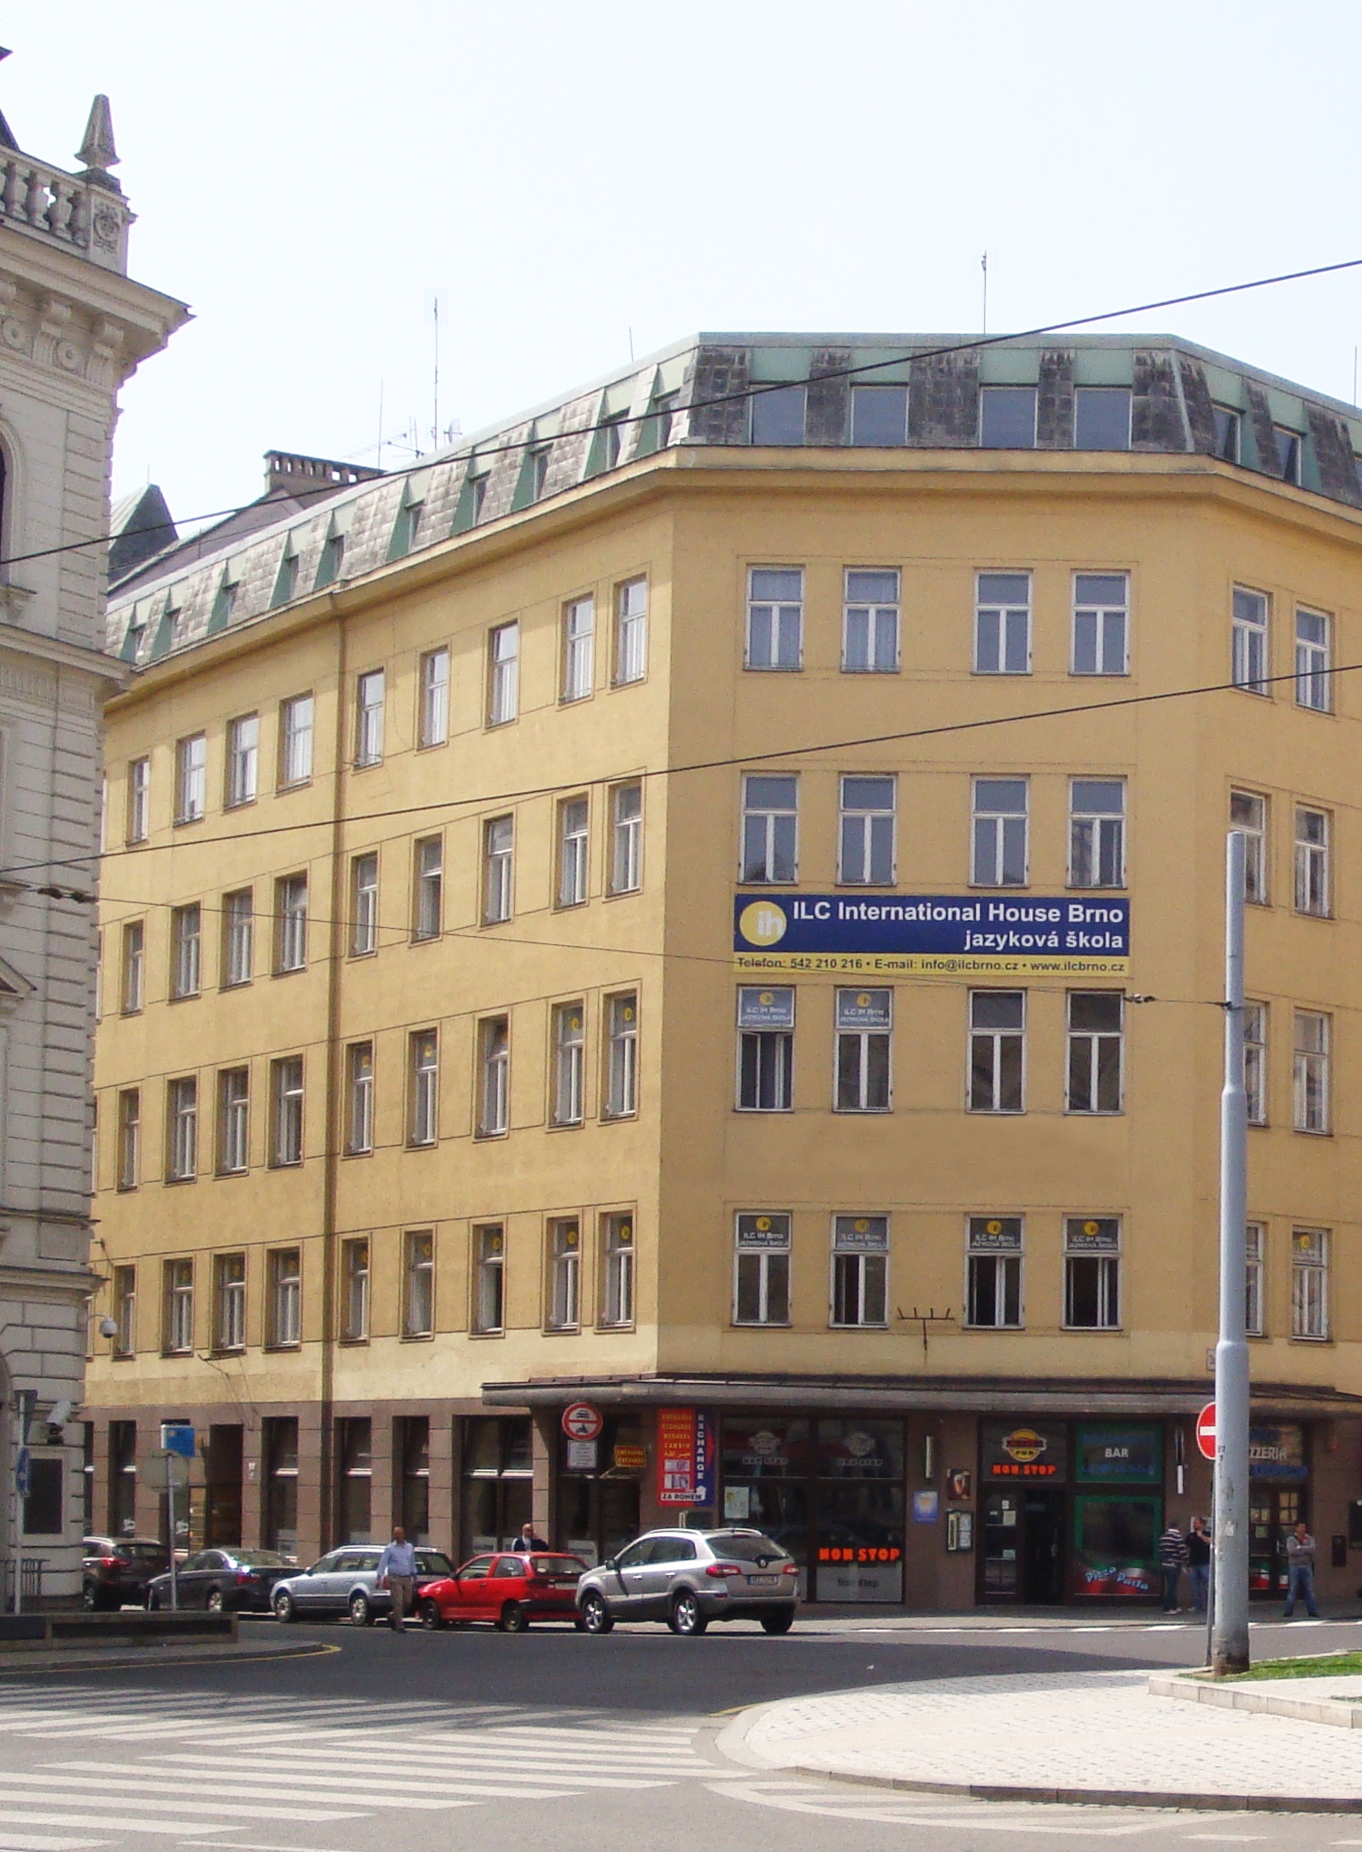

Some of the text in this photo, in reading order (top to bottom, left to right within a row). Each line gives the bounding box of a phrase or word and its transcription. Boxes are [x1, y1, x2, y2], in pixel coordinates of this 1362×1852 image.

[792, 900, 1124, 924] ILC International House Brno
[963, 930, 1123, 952] jazyková škola
[737, 957, 1125, 973] Telefon: 542 210 216 E-mail: info@ilcbrno.cz www.ilcbrno.cz
[696, 1414, 705, 1479] EXCHANGE
[1104, 1447, 1129, 1458] BAR
[1249, 1446, 1287, 1460] ZZERIA
[992, 1464, 1057, 1475] NON STOP
[818, 1548, 900, 1562] NON STOP
